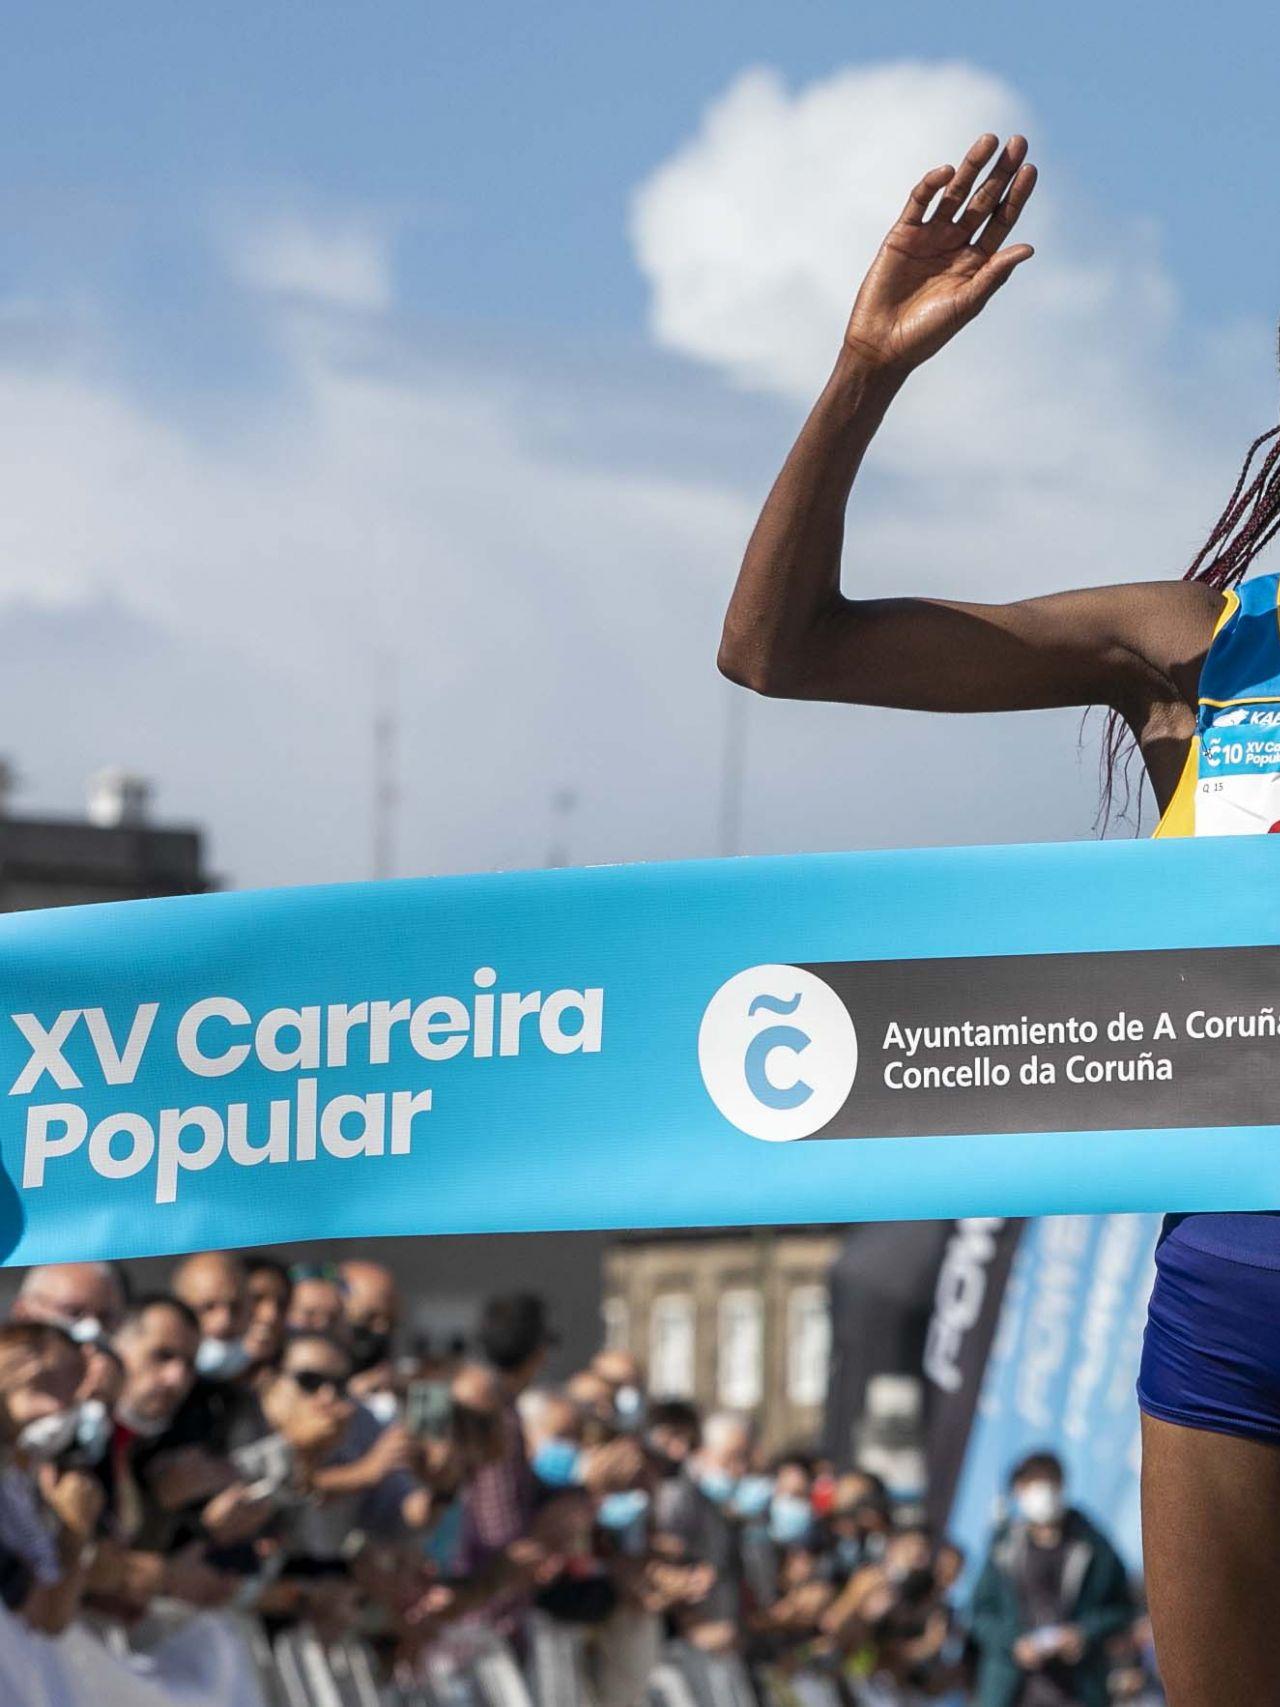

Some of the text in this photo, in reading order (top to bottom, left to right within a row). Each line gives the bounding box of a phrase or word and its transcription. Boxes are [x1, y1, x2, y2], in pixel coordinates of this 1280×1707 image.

[1245, 741, 1265, 753] XV
[8, 966, 604, 1095] XV Carreira
[882, 1016, 1099, 1056] Ayuntamiento
[1107, 1012, 1144, 1042] de
[1152, 1012, 1177, 1040] A
[883, 1052, 1174, 1089] Concello da Coruña
[22, 1077, 432, 1204] Popular
